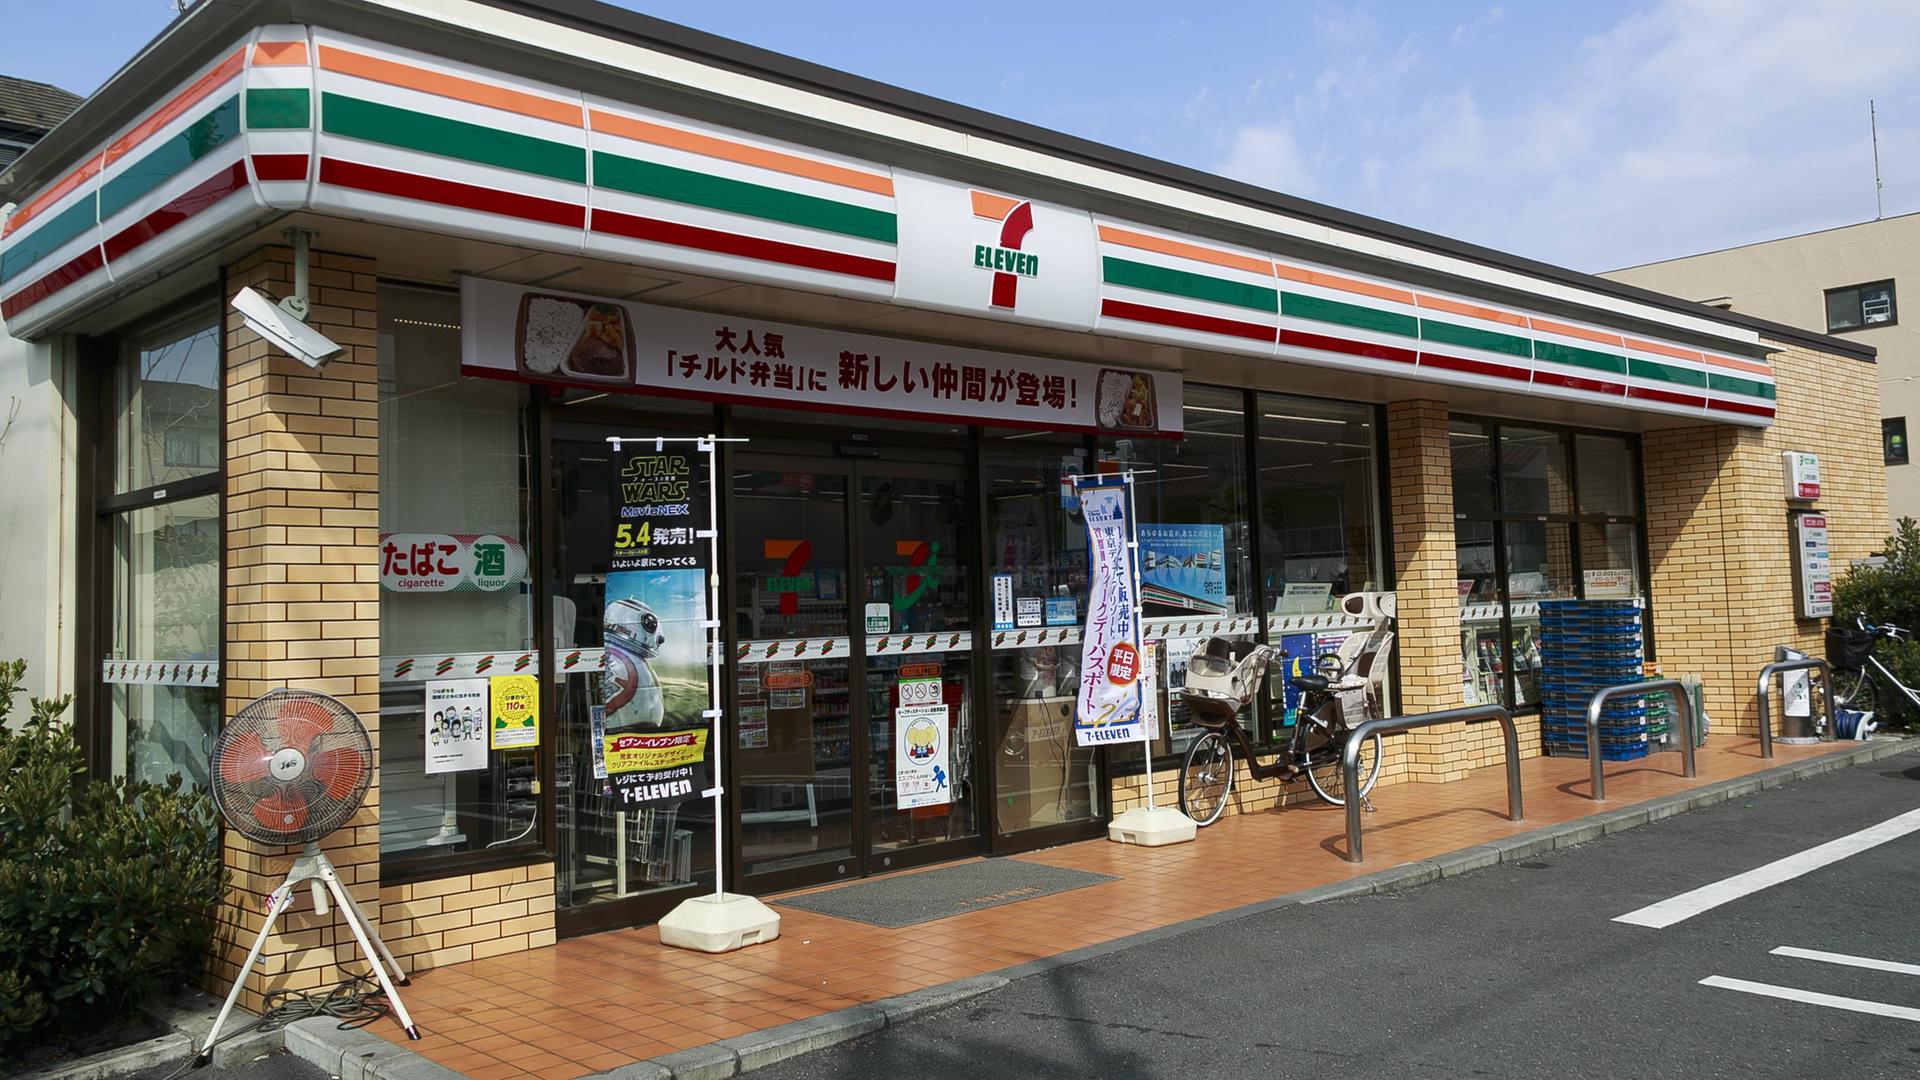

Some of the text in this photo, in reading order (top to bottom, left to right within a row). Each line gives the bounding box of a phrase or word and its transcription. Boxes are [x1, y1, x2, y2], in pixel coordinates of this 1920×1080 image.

[715, 326, 785, 359] 大人気
[621, 456, 690, 477] STAR
[622, 481, 690, 503] WARS
[621, 504, 690, 518] MovieNEX
[614, 522, 651, 548] 5.4
[382, 541, 506, 577] たばこ 酒
[612, 556, 697, 568] いよいよ家にやってくる
[398, 578, 507, 589] cigarette liquor
[1114, 649, 1134, 665] 平日
[1110, 663, 1132, 680] 限定
[619, 748, 687, 760] 完全オリジナルデザイン
